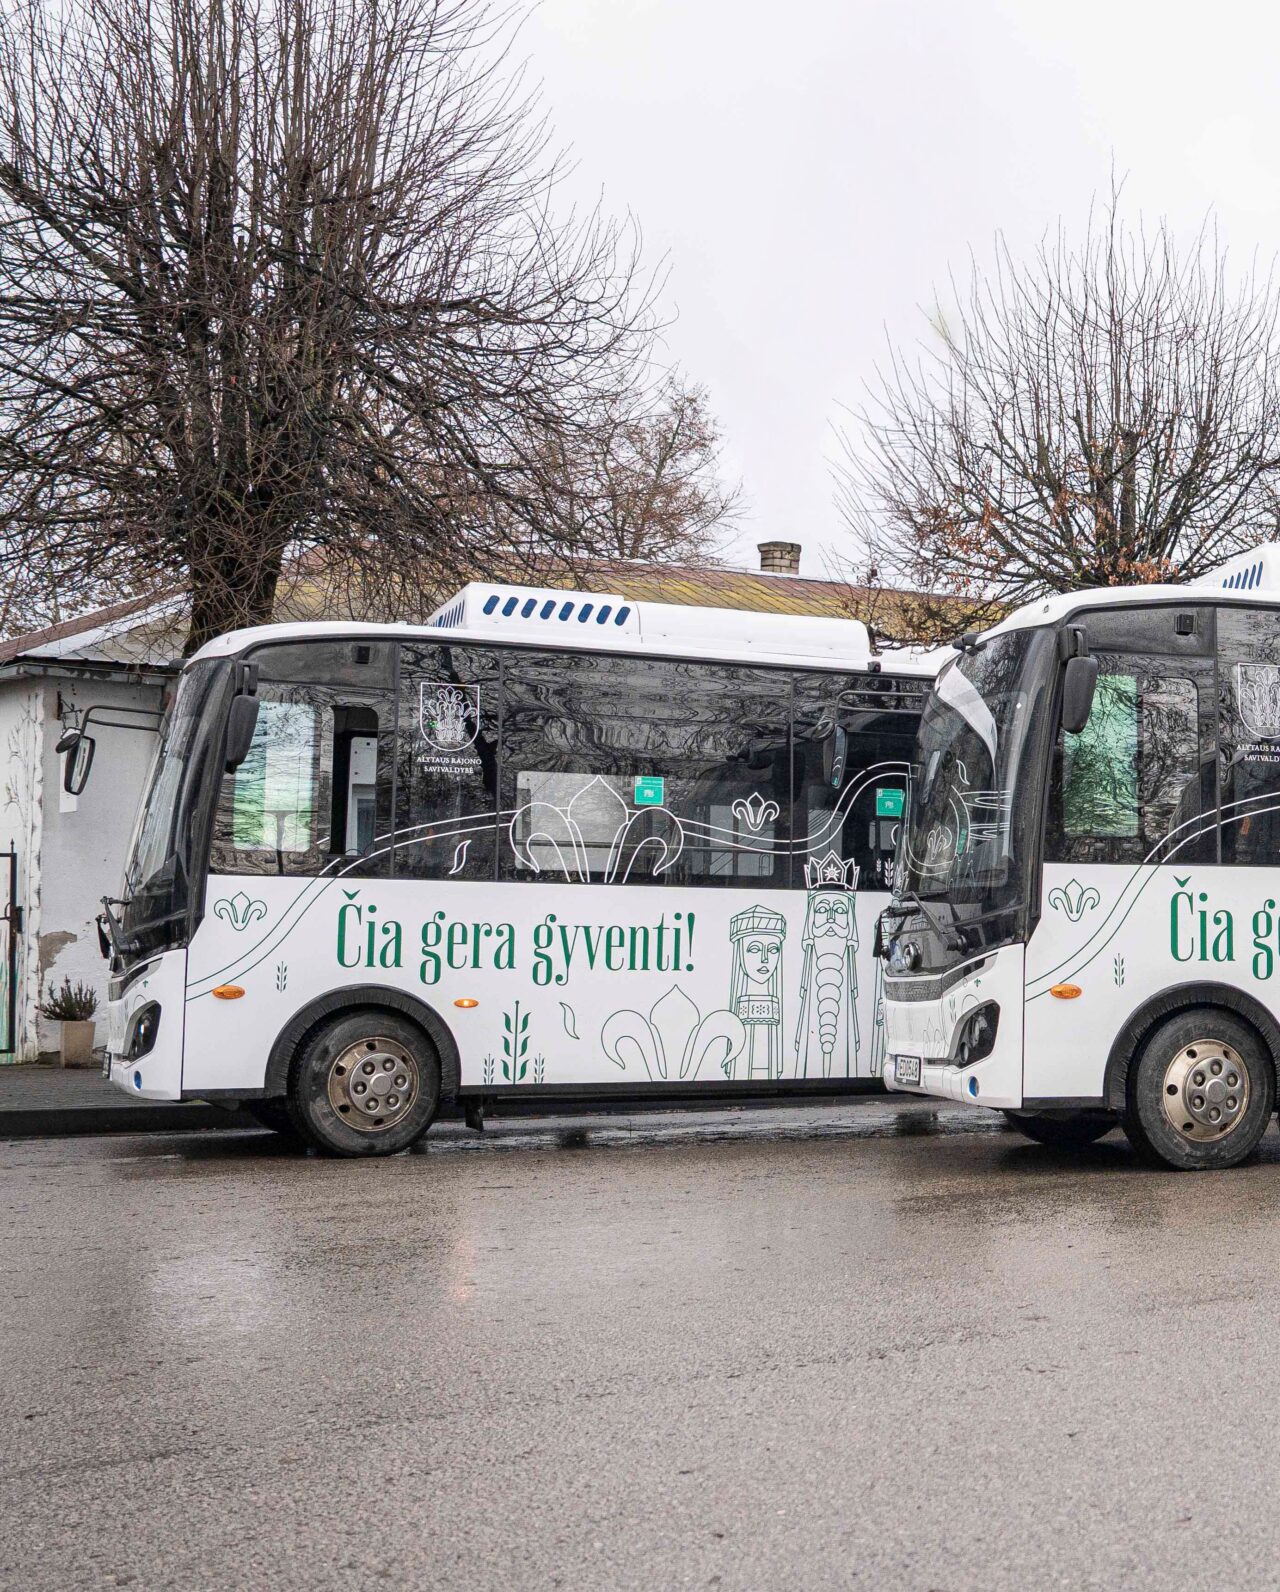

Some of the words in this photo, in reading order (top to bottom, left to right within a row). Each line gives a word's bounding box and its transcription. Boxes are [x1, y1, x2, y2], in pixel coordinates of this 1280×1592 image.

[1236, 744, 1270, 753] ALYTAUS
[417, 756, 450, 764] ALYTAUS
[451, 757, 482, 765] RAJONO
[424, 766, 474, 774] SAVIVALDYBĖ
[1170, 875, 1236, 962] Čia
[336, 889, 404, 969] Čia
[420, 910, 517, 985] gera
[532, 912, 695, 986] gyventi!
